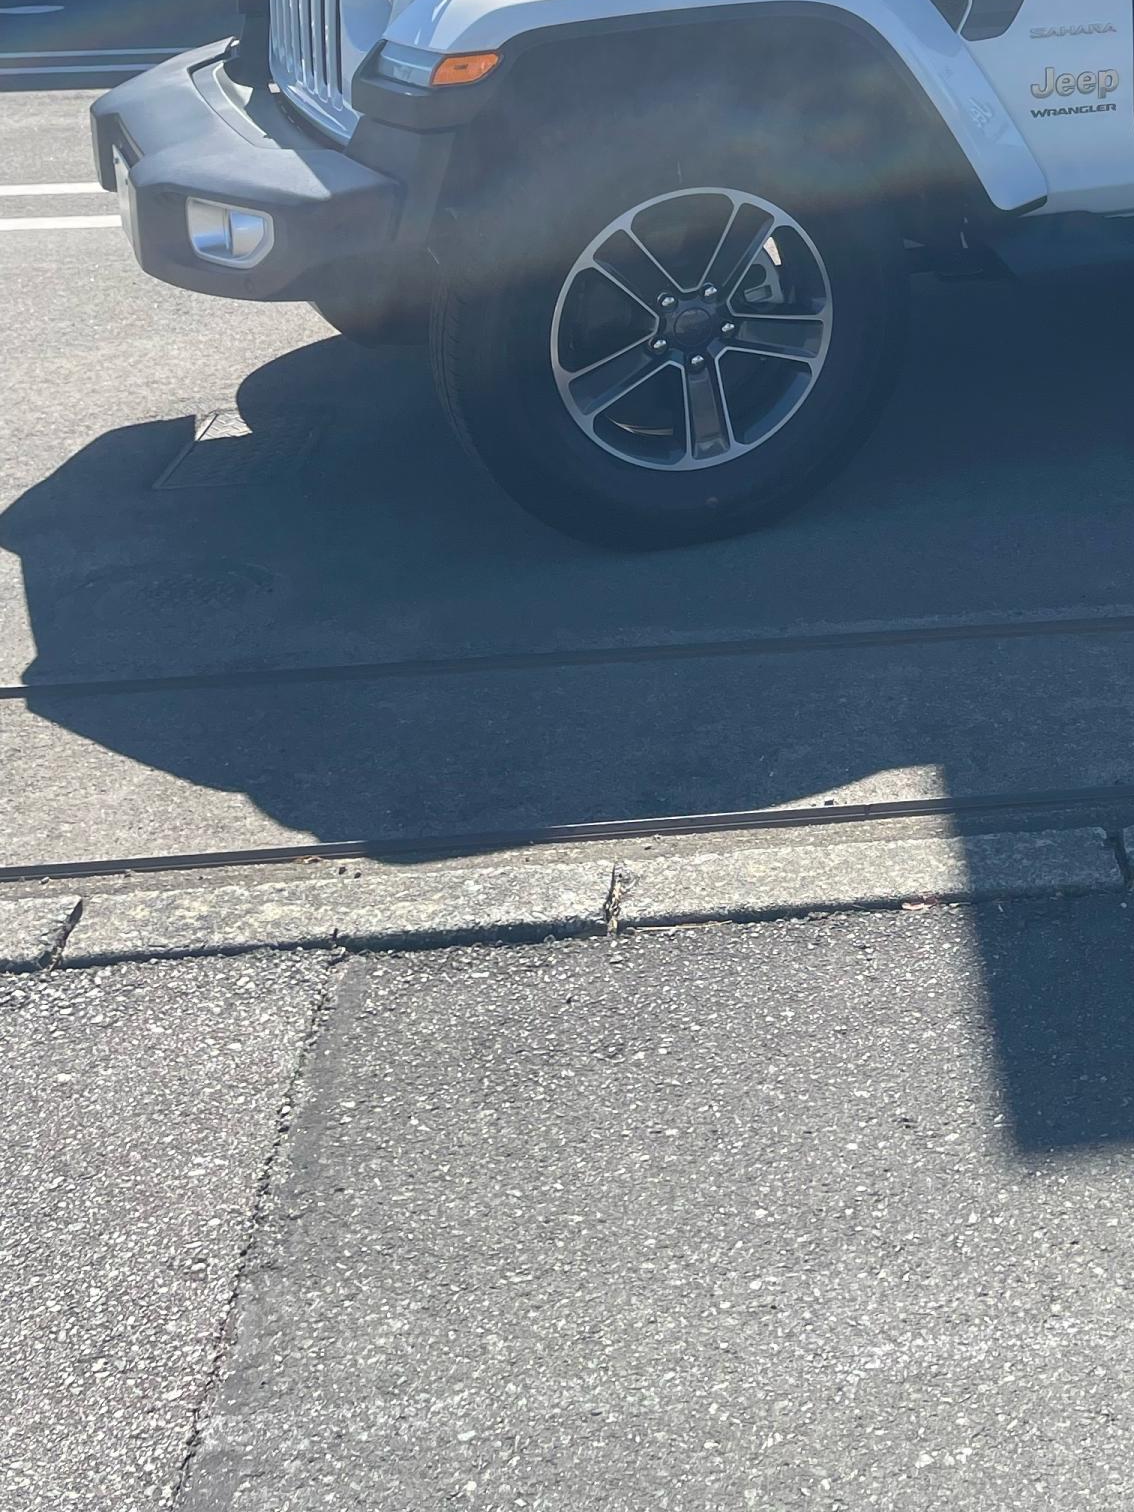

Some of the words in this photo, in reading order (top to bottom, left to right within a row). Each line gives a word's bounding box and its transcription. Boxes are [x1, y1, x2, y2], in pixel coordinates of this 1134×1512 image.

[1030, 22, 1117, 38] SAHARA
[1030, 66, 1119, 99] Jeep
[1030, 103, 1117, 118] WRANGLER
